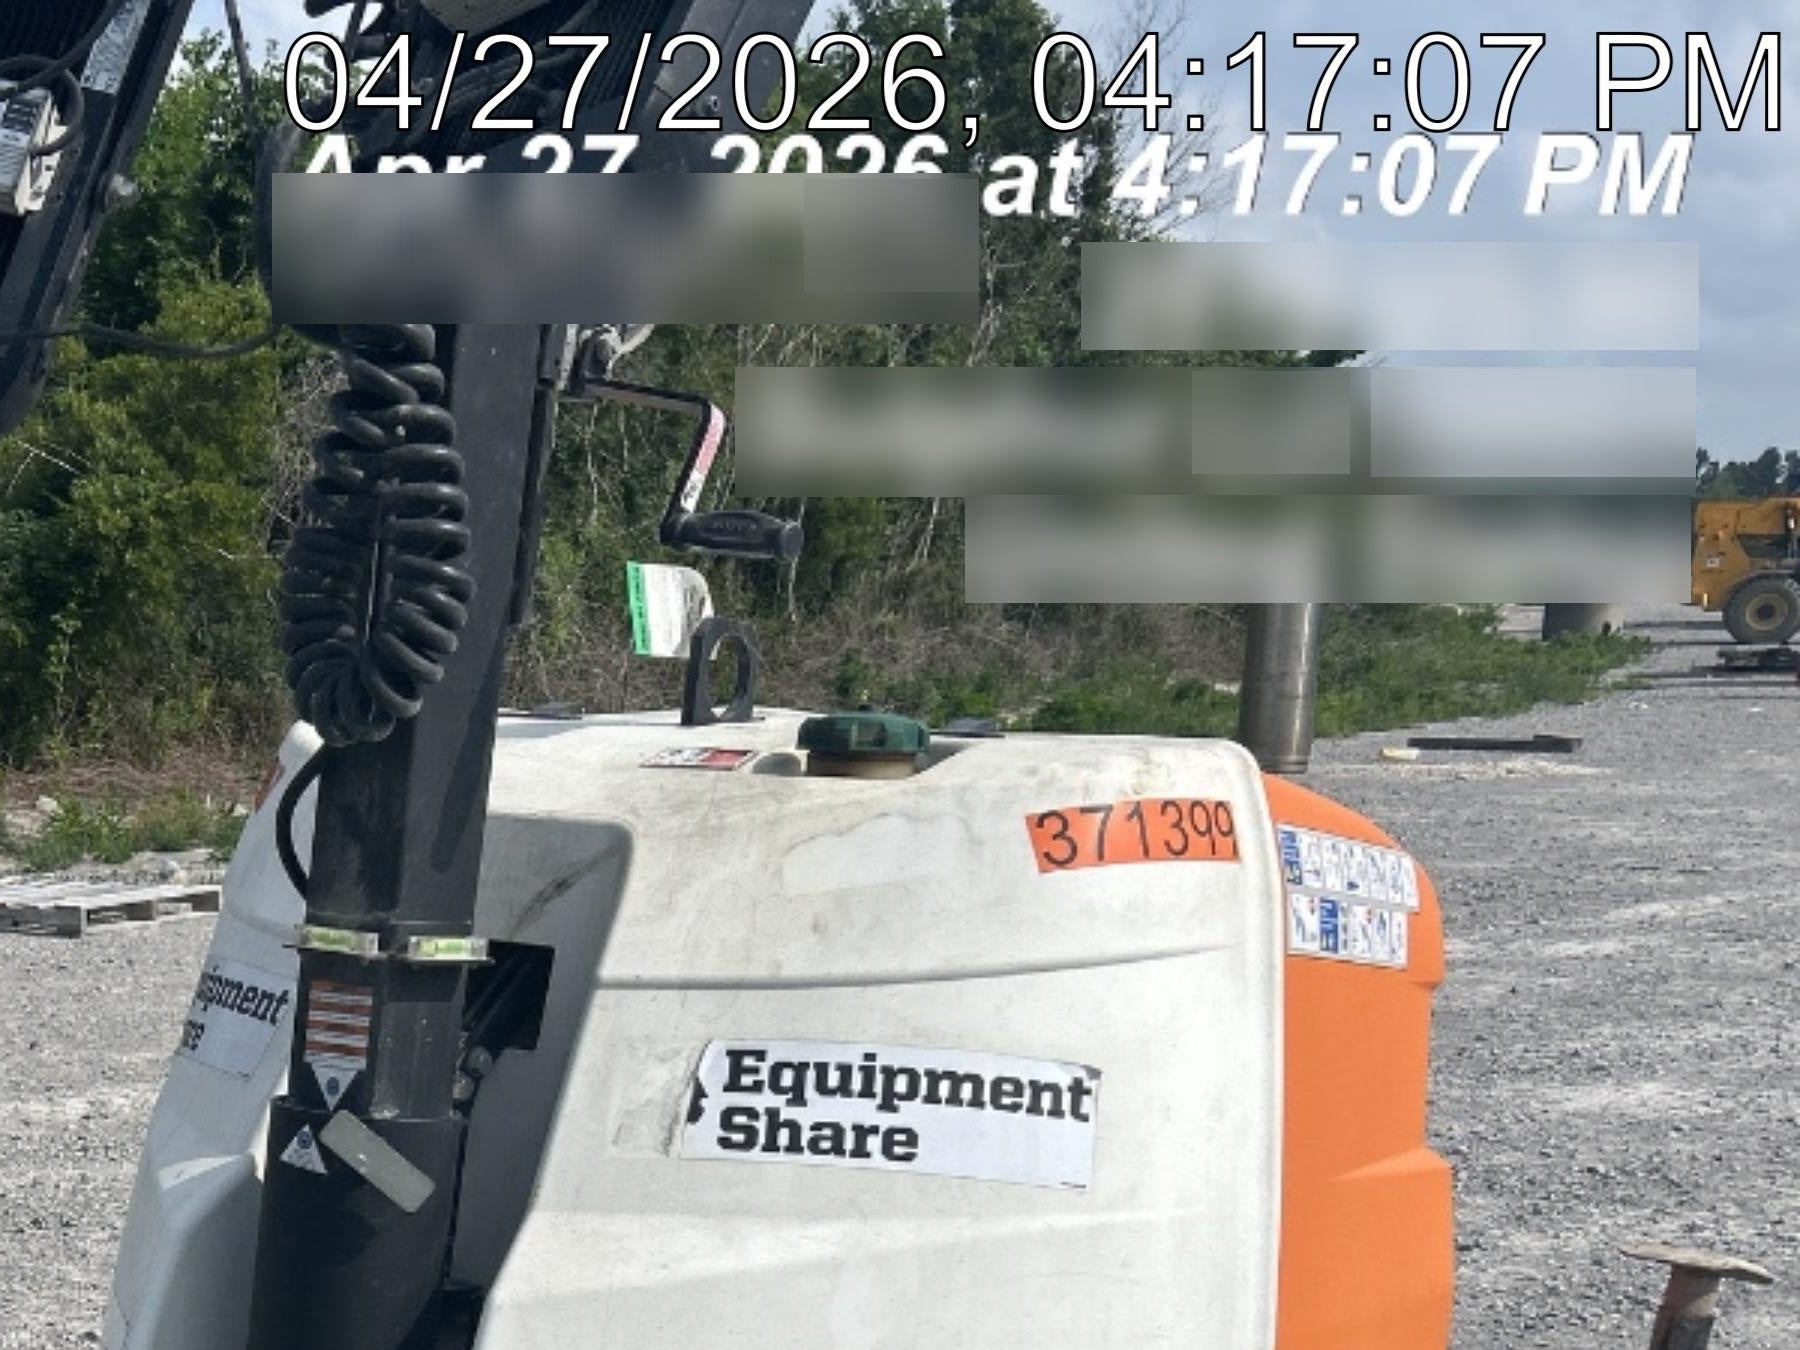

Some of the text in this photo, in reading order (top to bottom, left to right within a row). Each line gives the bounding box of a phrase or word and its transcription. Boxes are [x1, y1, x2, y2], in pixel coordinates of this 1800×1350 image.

[1036, 800, 1239, 867] 371399
[722, 1048, 1093, 1123] Equipment
[716, 1105, 920, 1163] Share
